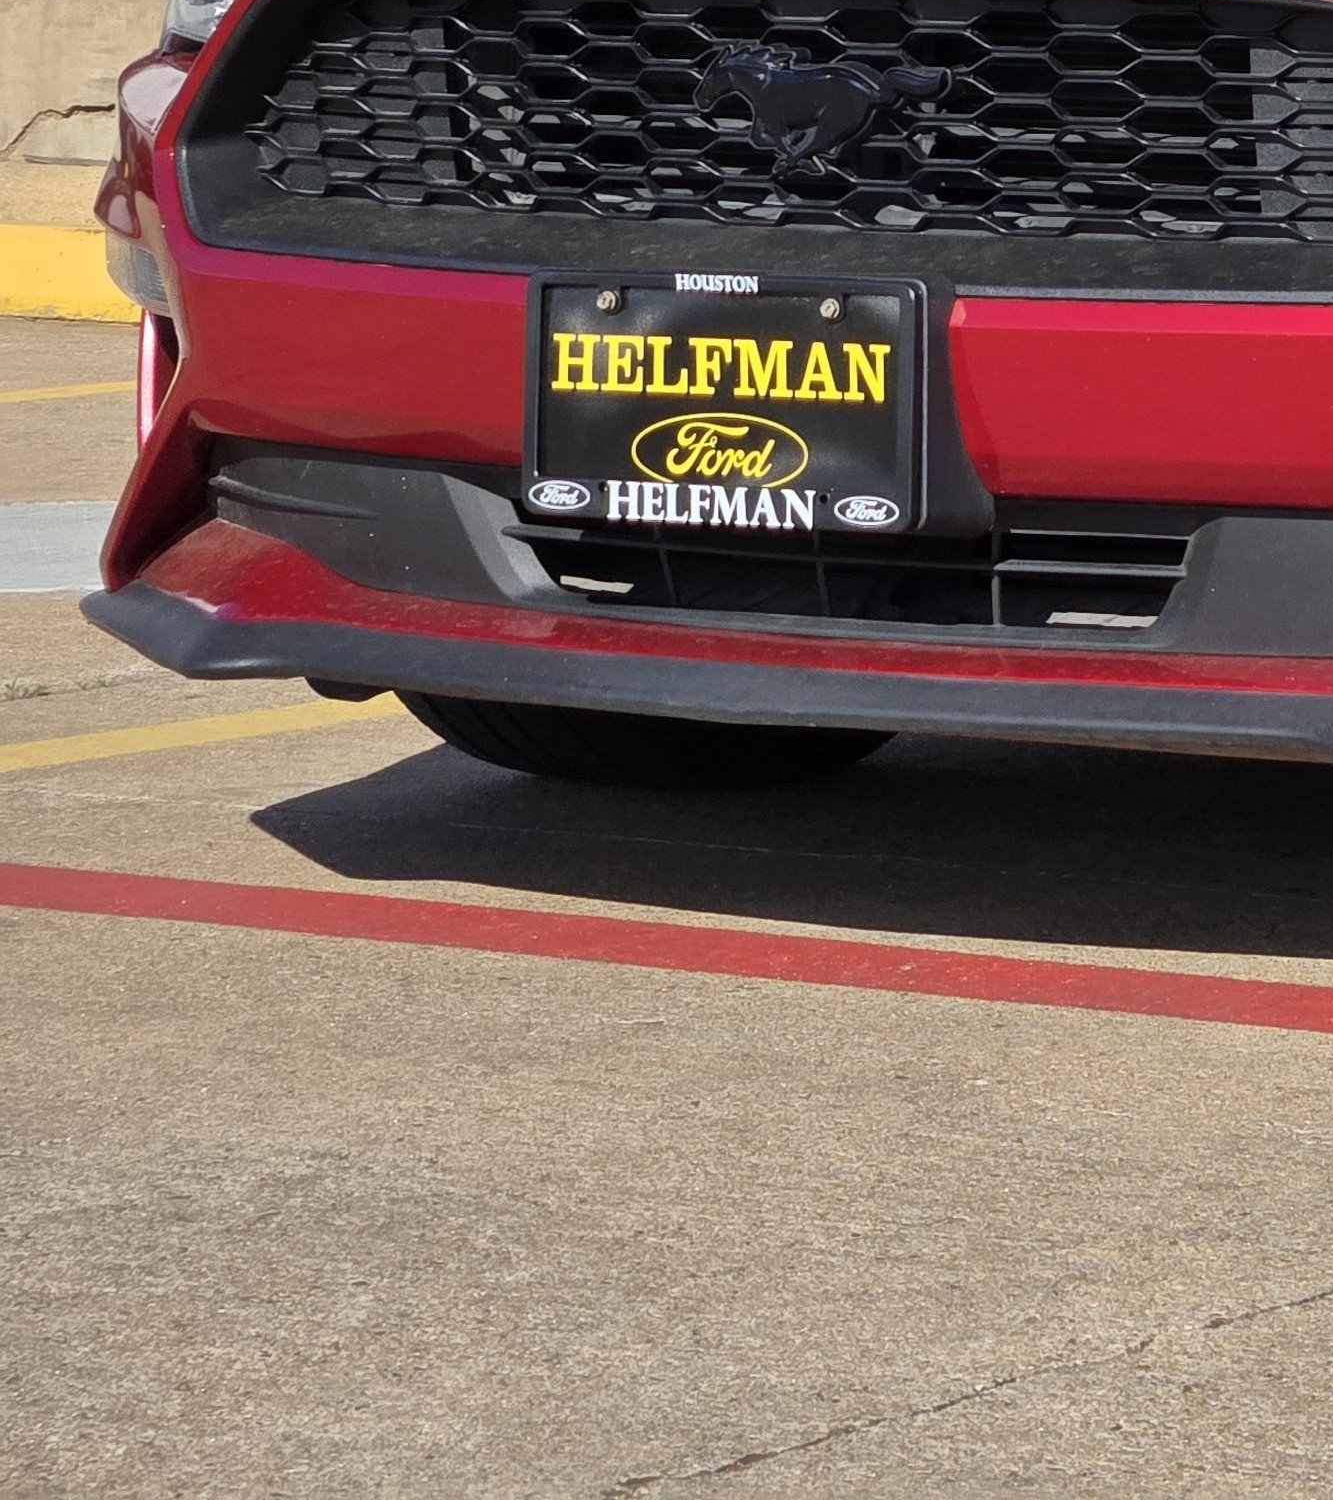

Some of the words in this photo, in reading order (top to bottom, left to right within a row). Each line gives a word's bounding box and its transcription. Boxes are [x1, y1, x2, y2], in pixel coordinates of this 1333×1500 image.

[674, 274, 759, 295] HOUSTON
[551, 333, 891, 404] HELFMAN
[666, 422, 775, 478] Ford
[538, 484, 579, 506] Ford
[606, 480, 817, 531] HELFMAN
[846, 500, 887, 522] Ford
